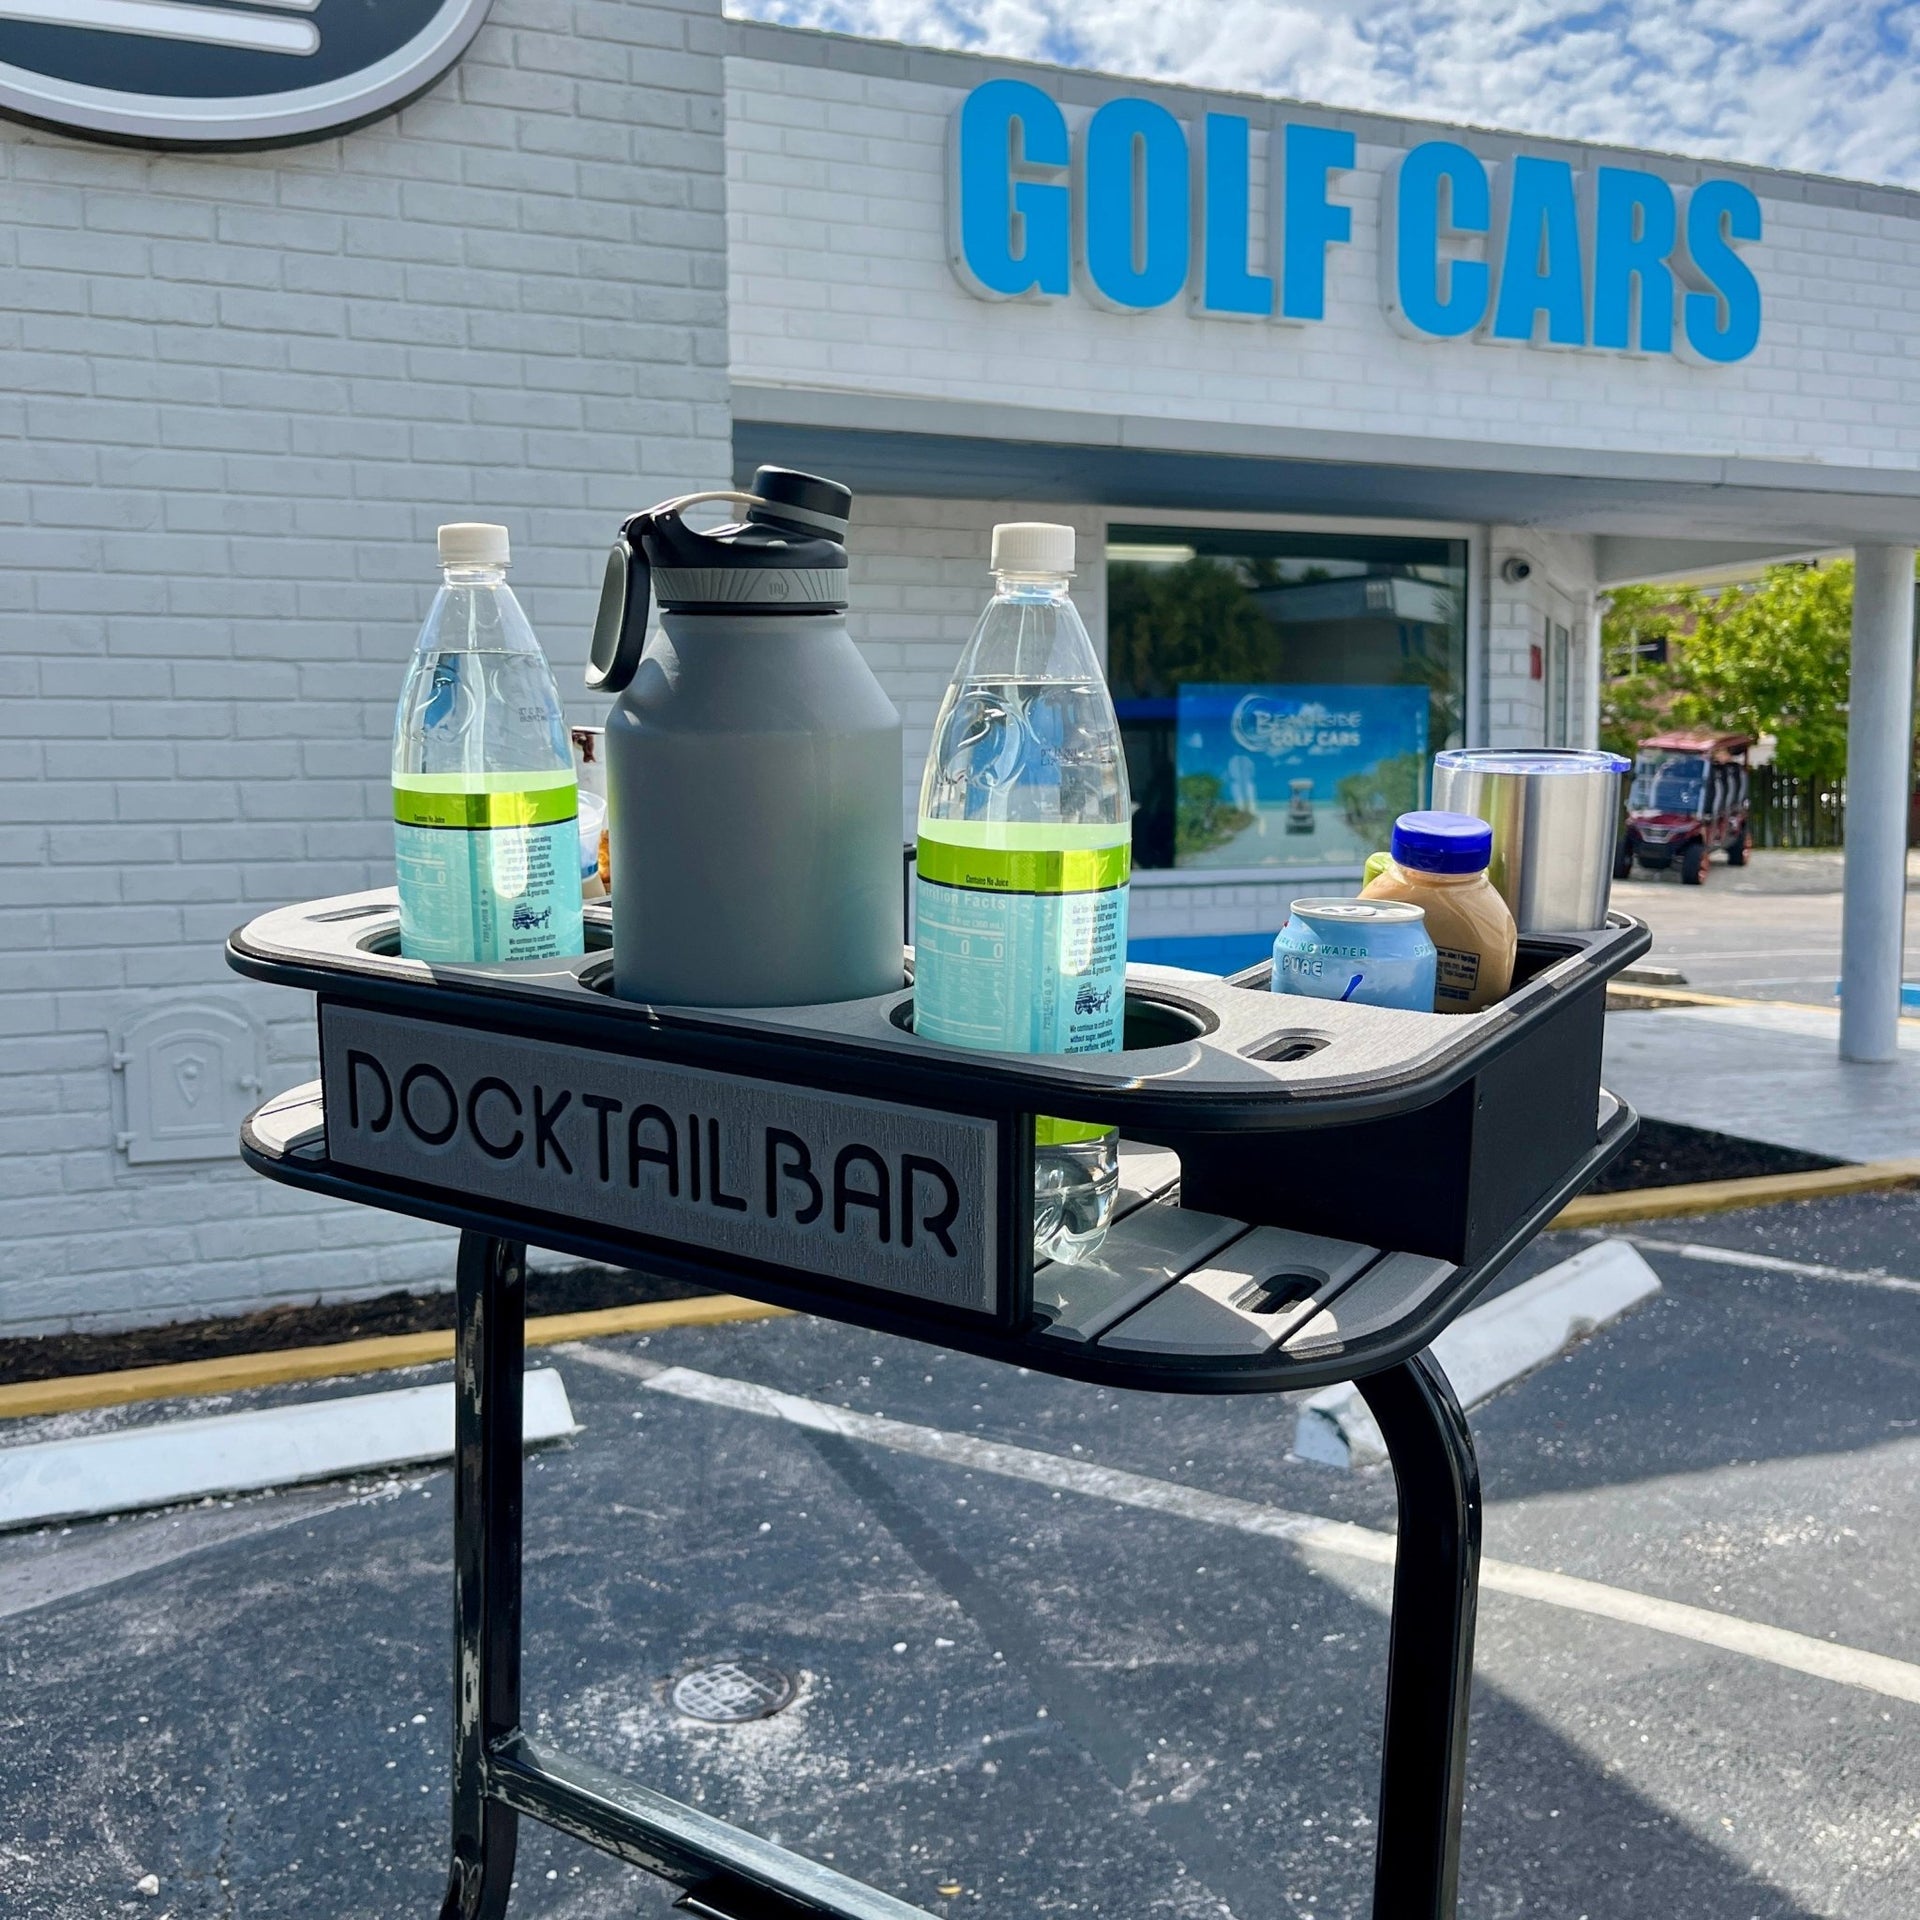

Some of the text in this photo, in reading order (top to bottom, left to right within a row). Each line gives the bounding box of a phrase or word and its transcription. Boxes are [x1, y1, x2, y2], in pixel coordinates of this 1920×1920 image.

[955, 78, 1762, 364] GOLF CARS
[1270, 730, 1361, 748] GOLF CARS
[986, 877, 995, 886] No
[995, 878, 1008, 887] Juice
[964, 892, 1006, 910] Facts
[961, 939, 1004, 959] 0 0
[1321, 944, 1368, 957] WATER
[1282, 953, 1322, 978] PURE
[347, 1048, 961, 1257] DOCKTAIL BAR
